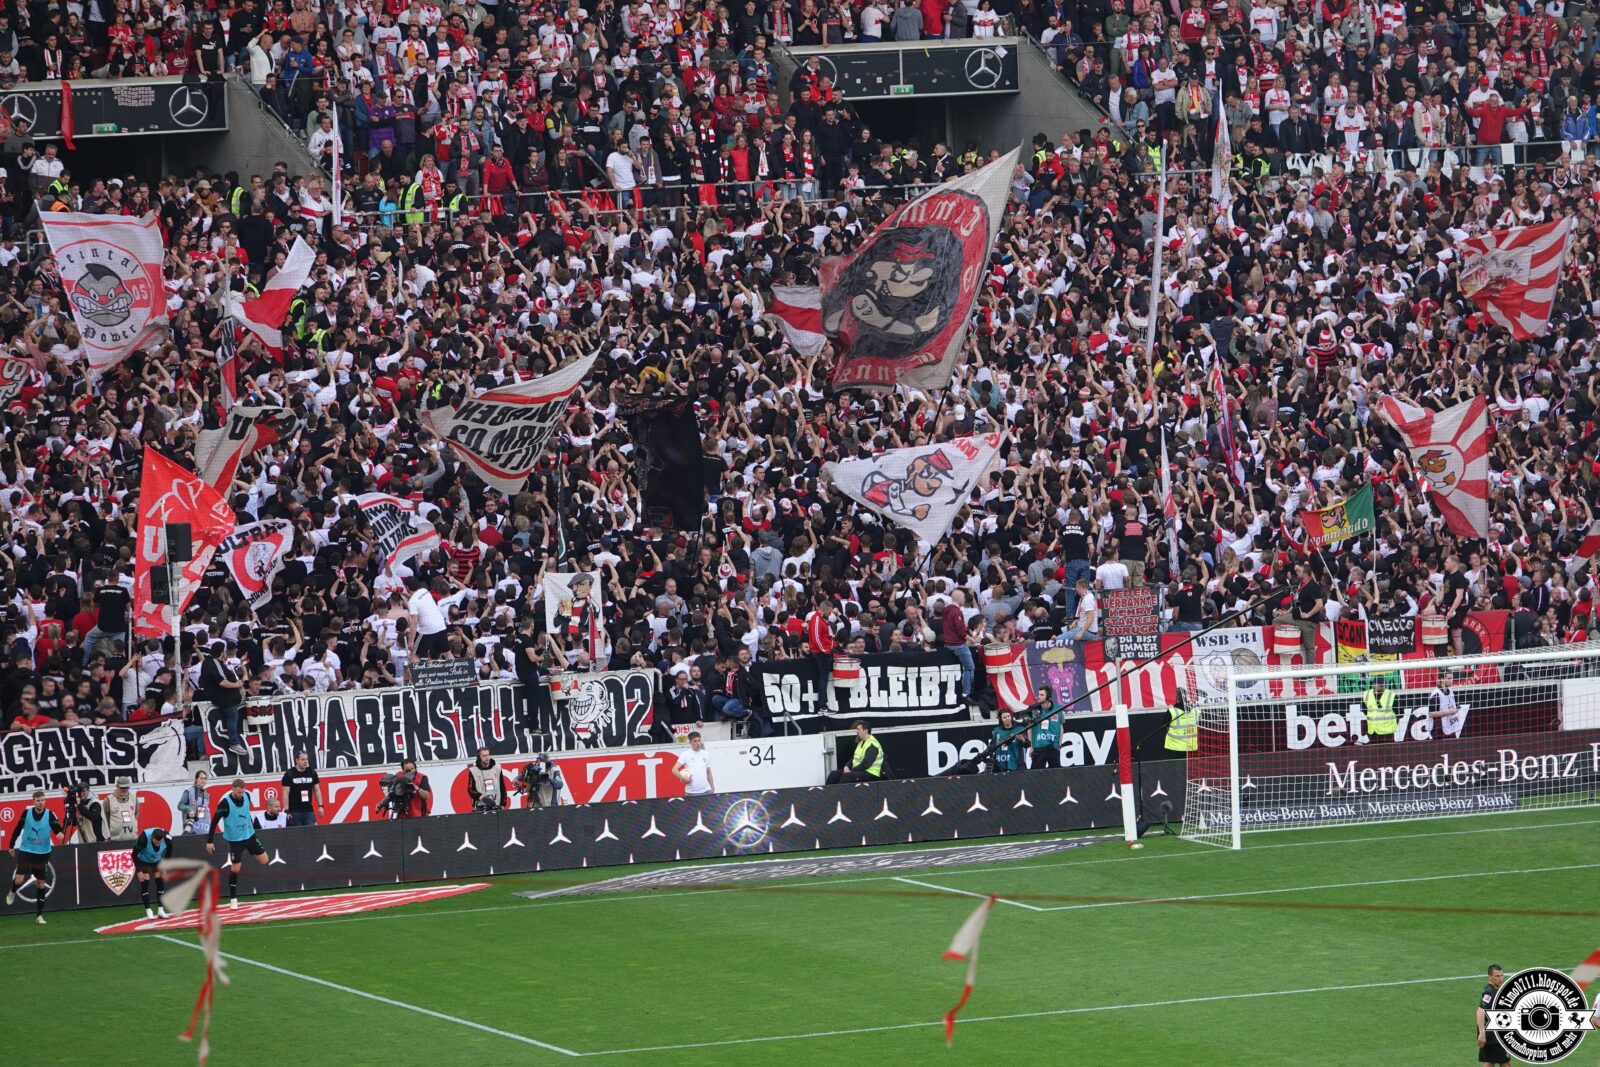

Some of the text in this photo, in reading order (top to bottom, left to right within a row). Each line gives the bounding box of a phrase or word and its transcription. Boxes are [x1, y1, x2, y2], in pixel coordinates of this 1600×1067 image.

[131, 284, 148, 301] 05
[82, 324, 137, 343] Power
[1109, 588, 1151, 598] JEDER
[1103, 595, 1158, 610] VERBANNTE
[1108, 606, 1153, 618] KEHRT
[1368, 618, 1414, 635] CHECCO
[1119, 634, 1158, 643] DU BIST
[1119, 642, 1158, 652] IMMER
[1195, 634, 1229, 648] WSB
[1120, 652, 1135, 660] BEI
[849, 663, 961, 709] BLEIBT
[600, 671, 653, 750] 02
[1285, 703, 1471, 751] betay
[749, 745, 776, 767] 34
[926, 729, 1116, 777] beay
[503, 751, 665, 806] GZİ
[1326, 747, 1578, 796] Mercedes-Benz
[1319, 802, 1357, 818] Bank
[1366, 797, 1475, 816] Mercedes-Benz
[1476, 792, 1514, 808] Bank
[122, 826, 134, 834] TV
